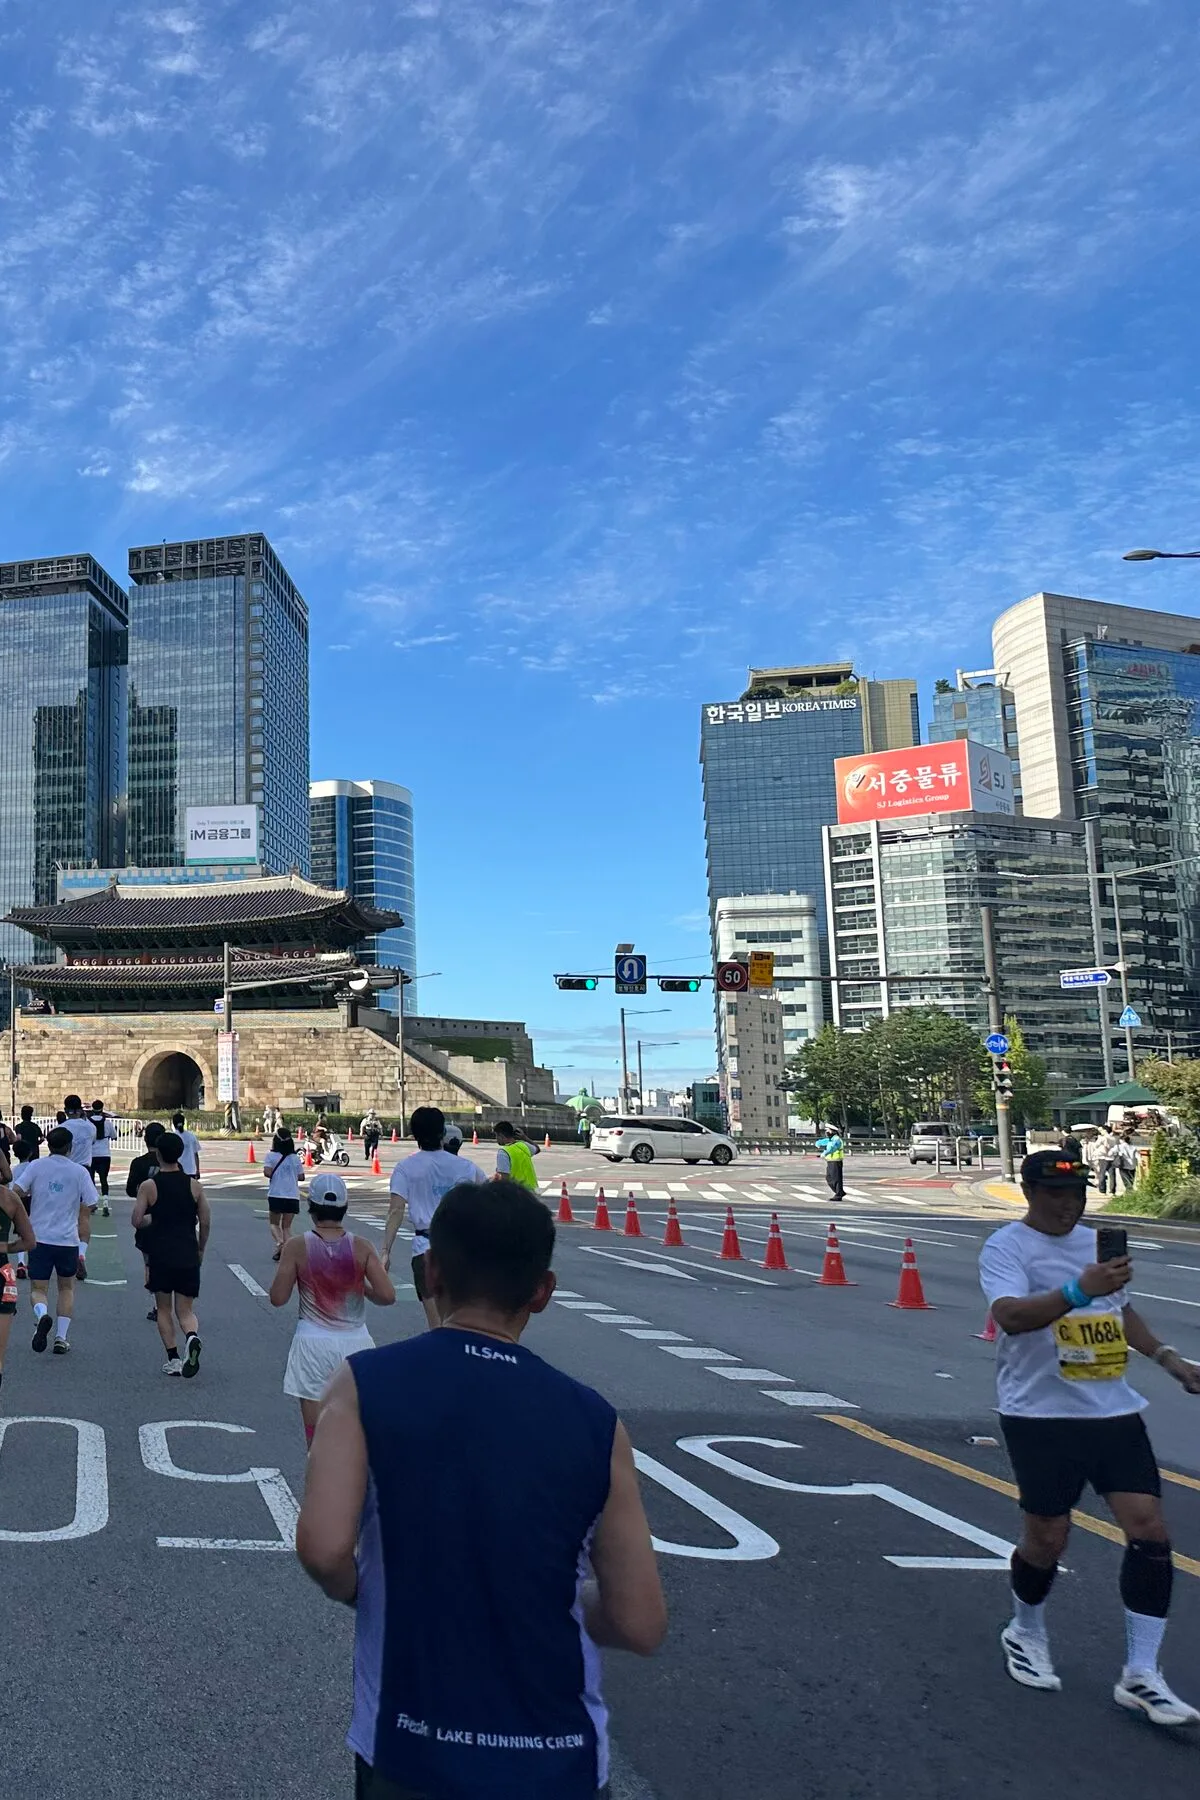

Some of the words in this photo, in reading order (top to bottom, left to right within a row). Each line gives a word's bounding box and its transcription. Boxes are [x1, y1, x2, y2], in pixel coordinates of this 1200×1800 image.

[706, 702, 783, 725] 한국일보
[783, 701, 820, 713] KOREA
[821, 698, 857, 711] TIMES
[866, 762, 962, 797] 서중물류
[994, 772, 1005, 789] SJ
[876, 801, 886, 809] SJ
[888, 796, 924, 807] Logistics
[924, 793, 950, 804] Group
[725, 971, 741, 984] 50
[1059, 1325, 1072, 1341] C
[1078, 1320, 1121, 1344] 11684
[465, 1344, 517, 1364] ILSAN
[436, 1728, 473, 1744] LAKE
[477, 1733, 543, 1749] RUNNING
[546, 1734, 584, 1750] CREW
